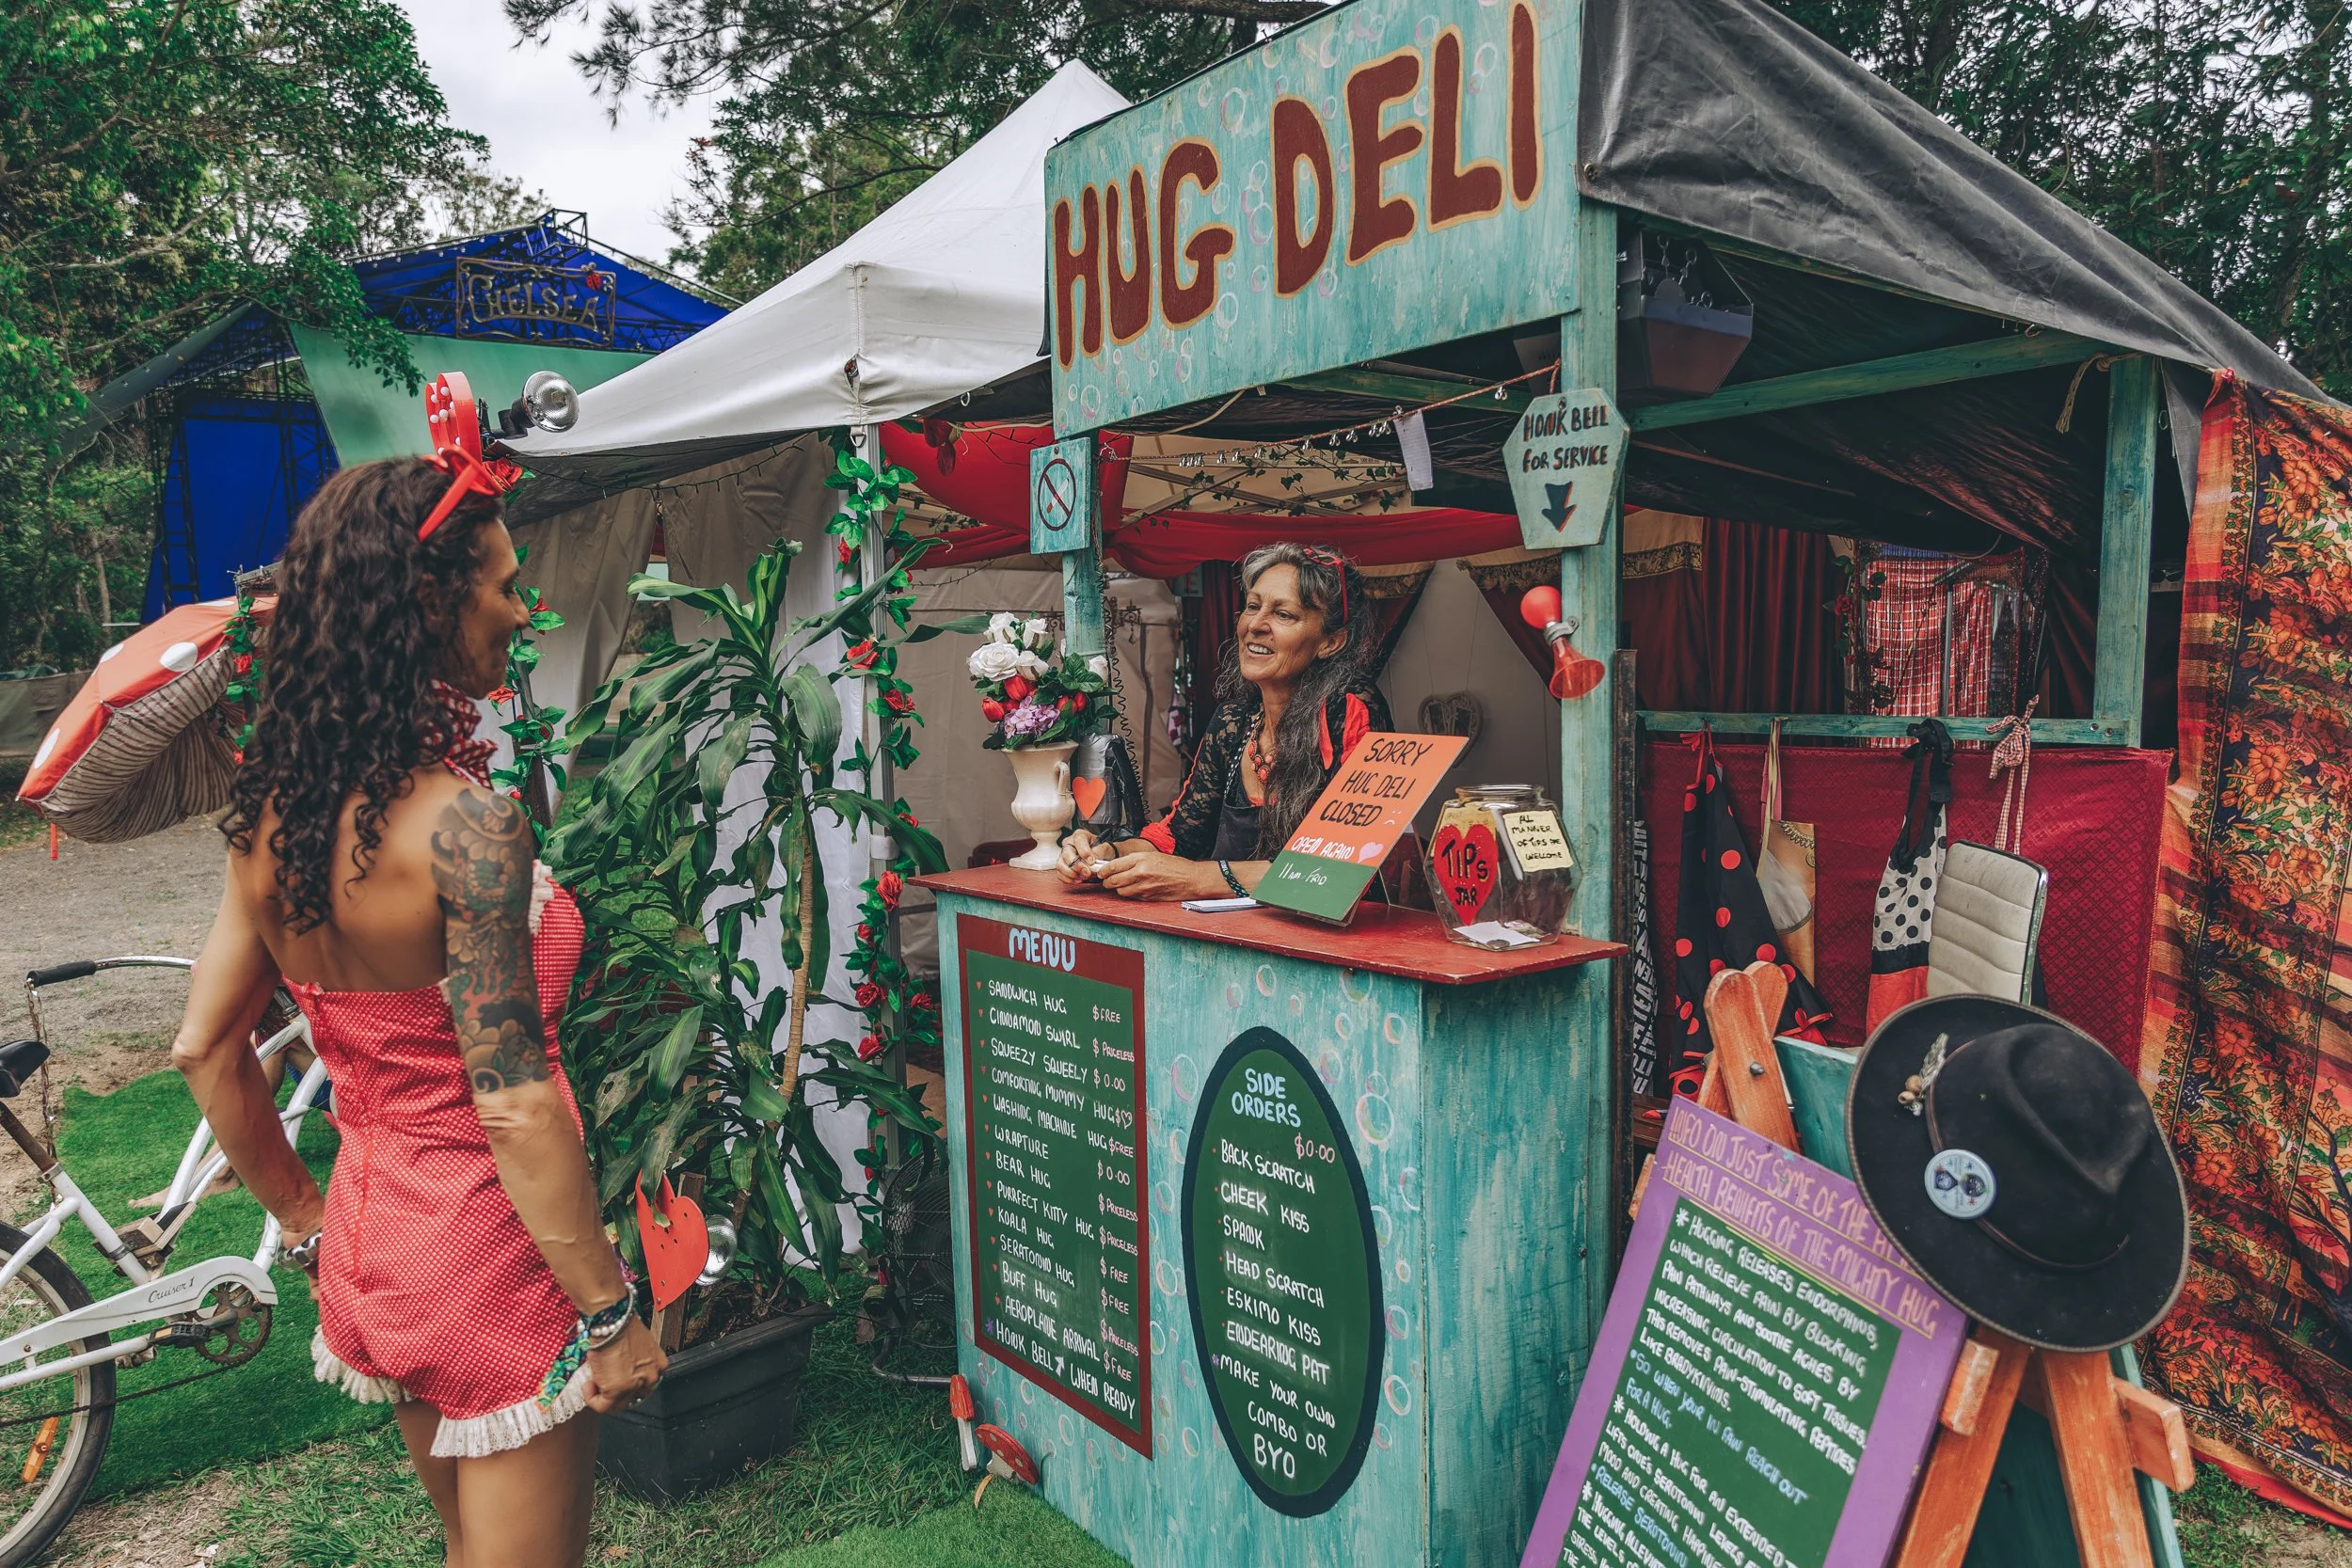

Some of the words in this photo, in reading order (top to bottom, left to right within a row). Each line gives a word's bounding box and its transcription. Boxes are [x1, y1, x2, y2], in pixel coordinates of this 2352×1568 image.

[1054, 136, 1236, 372] HUG
[1271, 0, 1543, 299] DELI
[1523, 410, 1567, 442] HONK
[1571, 405, 1609, 432] BELL
[1553, 445, 1609, 470] SERVICE
[1364, 738, 1433, 767] SORRY
[1341, 769, 1378, 794] HUG
[1374, 774, 1416, 800] DELI
[1320, 800, 1383, 827] CLOSED
[1291, 836, 1324, 854] OPEN
[1320, 842, 1355, 860] AGAIN
[1455, 887, 1477, 907] JAR
[1009, 927, 1076, 972] MENU
[989, 980, 1037, 1006] SANDWICH
[1043, 994, 1067, 1015] HUG
[990, 1007, 1041, 1037] CINNAMON
[1046, 1024, 1081, 1049] SWIRL
[991, 1037, 1036, 1066] SQUEEZY
[1043, 1055, 1088, 1084] SQUEELY
[1246, 1068, 1286, 1100] SIDE
[992, 1067, 1041, 1098] COMFORTING
[1045, 1085, 1085, 1112] MUMMY
[1093, 1101, 1115, 1123] HUG
[993, 1094, 1032, 1124] WASHING
[1038, 1114, 1077, 1139] MACHINE
[1088, 1130, 1106, 1149] HUG
[1232, 1092, 1301, 1128] ORDERS
[994, 1124, 1049, 1160] WRAPTURE
[1221, 1138, 1253, 1171] BACK
[1255, 1155, 1315, 1194] SCRATCH
[996, 1150, 1025, 1178] BEAR
[1030, 1166, 1051, 1189] HUG
[1669, 1106, 1702, 1148] INFO
[1703, 1124, 1728, 1161] ON
[1726, 1136, 1772, 1183] JUST
[1812, 1187, 1838, 1222] OF
[1837, 1198, 1869, 1241] THE
[997, 1180, 1038, 1213] PURRFECT
[1043, 1201, 1068, 1226] KITTY
[1075, 1216, 1094, 1240] HUG
[998, 1208, 1027, 1235] KOALA
[1036, 1227, 1055, 1249] HUG
[1220, 1181, 1268, 1216] CHEEK
[1280, 1204, 1310, 1234] KISS
[1223, 1214, 1265, 1251] SPANK
[1662, 1150, 1713, 1201] HEALTH
[1774, 1215, 1799, 1249] OF
[1800, 1228, 1833, 1269] THE
[1830, 1244, 1899, 1307] MIGHTY
[1898, 1283, 1940, 1340] HUG
[1689, 1215, 1735, 1258] HUGGING
[1738, 1246, 1791, 1293] RELEASES
[149, 1283, 186, 1304] Cruiser
[1002, 1261, 1026, 1291] BUFF
[1035, 1279, 1057, 1307] HUG
[1056, 1265, 1074, 1288] HUG
[1226, 1251, 1260, 1279] HEAD
[1265, 1268, 1325, 1308] SCRATCH
[1005, 1295, 1057, 1341] AEROPLANE
[1063, 1327, 1100, 1362] ARRIVAL
[1227, 1287, 1279, 1325] ESKIMO
[1288, 1315, 1321, 1346] KISS
[1661, 1259, 1684, 1285] PAIN
[1685, 1274, 1733, 1316] PATHWAYS
[1733, 1309, 1756, 1328] AND
[1755, 1322, 1793, 1354] SOOTHE
[1792, 1348, 1834, 1385] ACHES
[1837, 1377, 1861, 1402] BY
[1670, 1239, 1704, 1269] WHICH
[1704, 1258, 1752, 1298] RELIEVE
[1753, 1291, 1782, 1317] PAIN
[1783, 1307, 1805, 1331] BY
[1804, 1322, 1867, 1379] BLOCKING
[1227, 1320, 1296, 1371] ENDEARING
[1302, 1353, 1329, 1386] PAT
[1640, 1326, 1664, 1357] LIKE
[1654, 1287, 1710, 1336] INCREASING
[1712, 1327, 1787, 1384] CIRCULATION
[1777, 1369, 1793, 1390] TO
[1793, 1383, 1822, 1412] SOFT
[996, 1319, 1026, 1354] HONK
[1031, 1340, 1054, 1372] BELL
[1070, 1363, 1098, 1397] WHEN
[1104, 1382, 1135, 1419] READY
[1220, 1354, 1259, 1387] MAKE
[1270, 1379, 1299, 1410] YOUR
[1306, 1401, 1335, 1429] OWN
[1626, 1376, 1643, 1404] FOR
[1642, 1390, 1651, 1409] A
[1646, 1307, 1666, 1331] THIS
[1666, 1321, 1711, 1362] REMOVES
[1809, 1426, 1857, 1475] PEPTIDES
[1248, 1401, 1297, 1443] COMBO
[1306, 1433, 1327, 1457] OR
[1636, 1353, 1651, 1374] SO
[1654, 1370, 1680, 1397] WHEN
[1677, 1392, 1706, 1420] YOUR
[1707, 1414, 1721, 1434] IN
[1721, 1426, 1743, 1452] PAIN
[1745, 1446, 1782, 1485] REACH
[1778, 1479, 1809, 1505] OUT
[1253, 1433, 1295, 1479] BYO
[1598, 1441, 1622, 1471] MOOD
[1621, 1466, 1641, 1489] AND
[1640, 1485, 1679, 1533] CREATING
[1605, 1420, 1628, 1450] LIFTS
[1653, 1467, 1706, 1527] SEROTONIN
[1709, 1522, 1744, 1567] LEVELS
[1624, 1408, 1661, 1452] HOLDING
[1660, 1442, 1669, 1457] A
[1670, 1449, 1690, 1476] HUG
[1690, 1466, 1708, 1495] FOR
[1708, 1490, 1726, 1513] AN
[1725, 1506, 1785, 1567] EXTENDED
[1591, 1491, 1626, 1541] HUGGING
[1596, 1465, 1635, 1512] RELEASE
[1634, 1507, 1689, 1568] SEROTONIN
